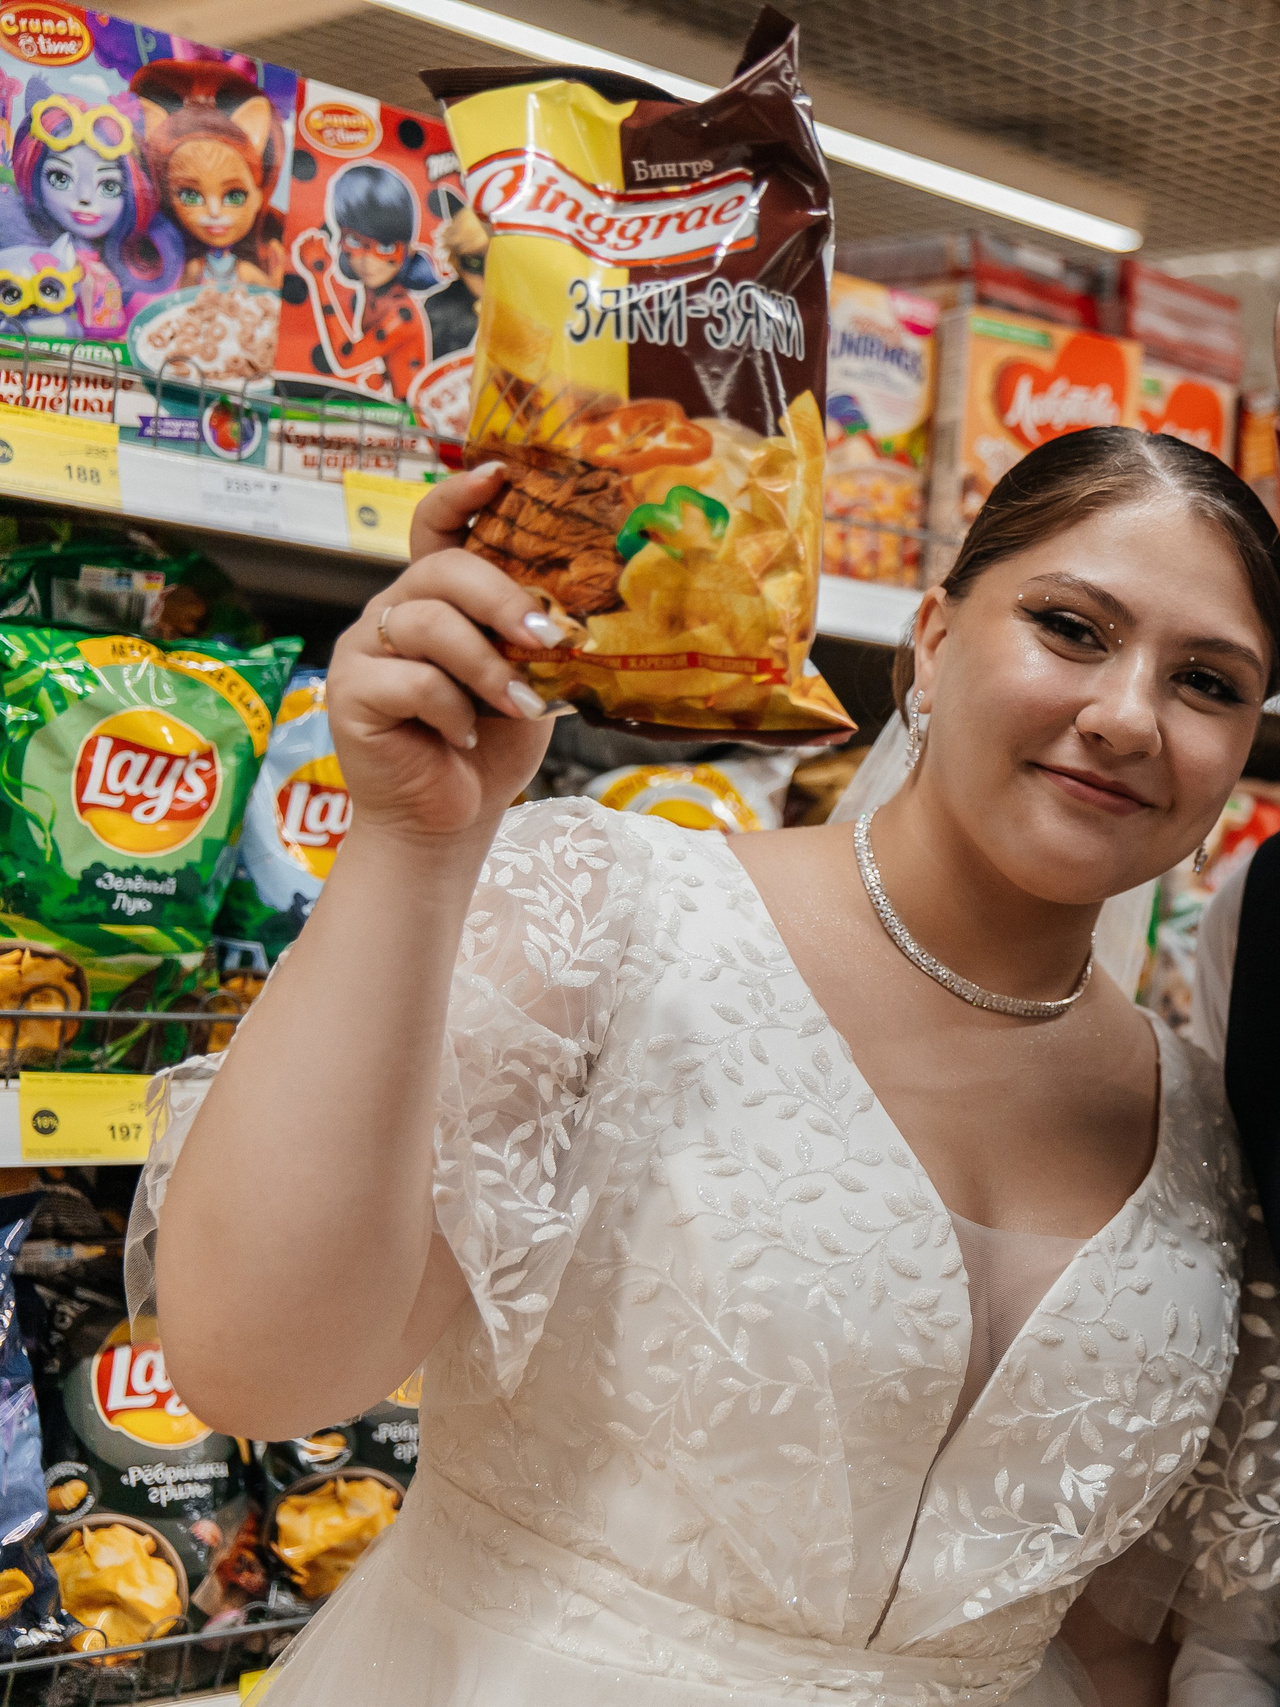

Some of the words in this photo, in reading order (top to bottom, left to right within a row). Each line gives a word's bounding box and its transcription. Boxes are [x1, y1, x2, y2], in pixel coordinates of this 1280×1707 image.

[1, 12, 81, 37] Crunch
[632, 159, 714, 182] Бингрэ
[474, 164, 746, 252] Binggrae
[63, 464, 101, 485] 188
[81, 735, 213, 824] Lay's
[284, 780, 350, 846] La
[109, 1123, 144, 1142] 197
